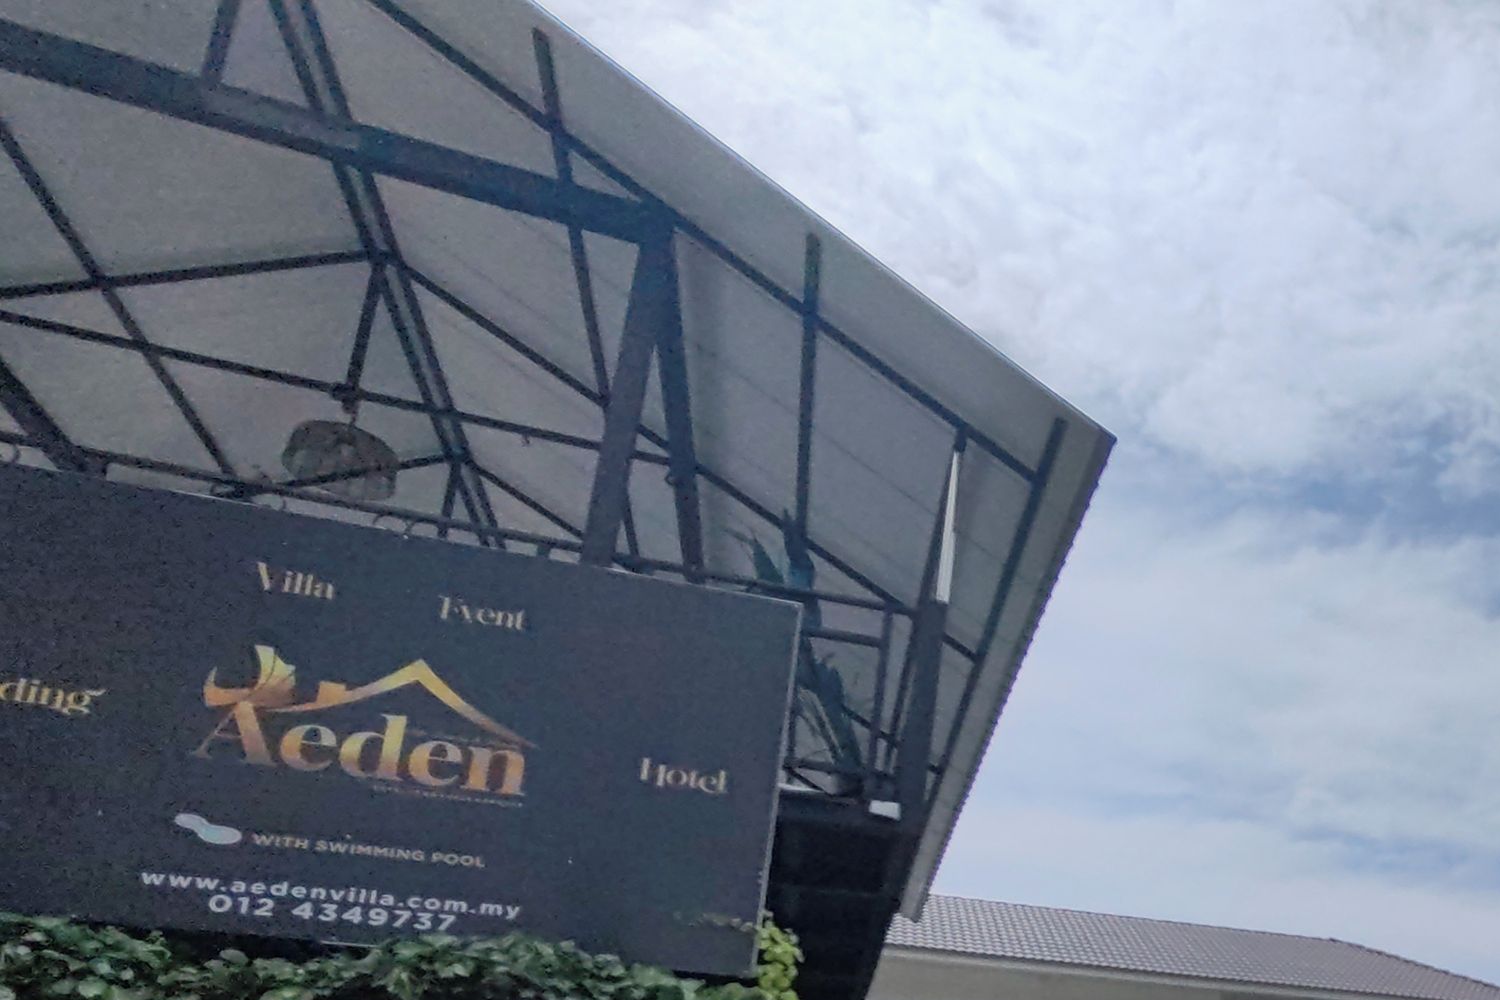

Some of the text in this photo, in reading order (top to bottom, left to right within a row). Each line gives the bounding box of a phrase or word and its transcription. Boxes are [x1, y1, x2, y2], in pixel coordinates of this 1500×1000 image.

[257, 561, 335, 600] Villa
[438, 595, 527, 631] Event
[190, 700, 526, 797] Aeden
[639, 757, 728, 794] Hotel
[251, 832, 486, 868] WITH SWIMMING POOL
[141, 870, 521, 921] www.aedenvilla.com.my
[208, 895, 457, 931] 012 4349737
